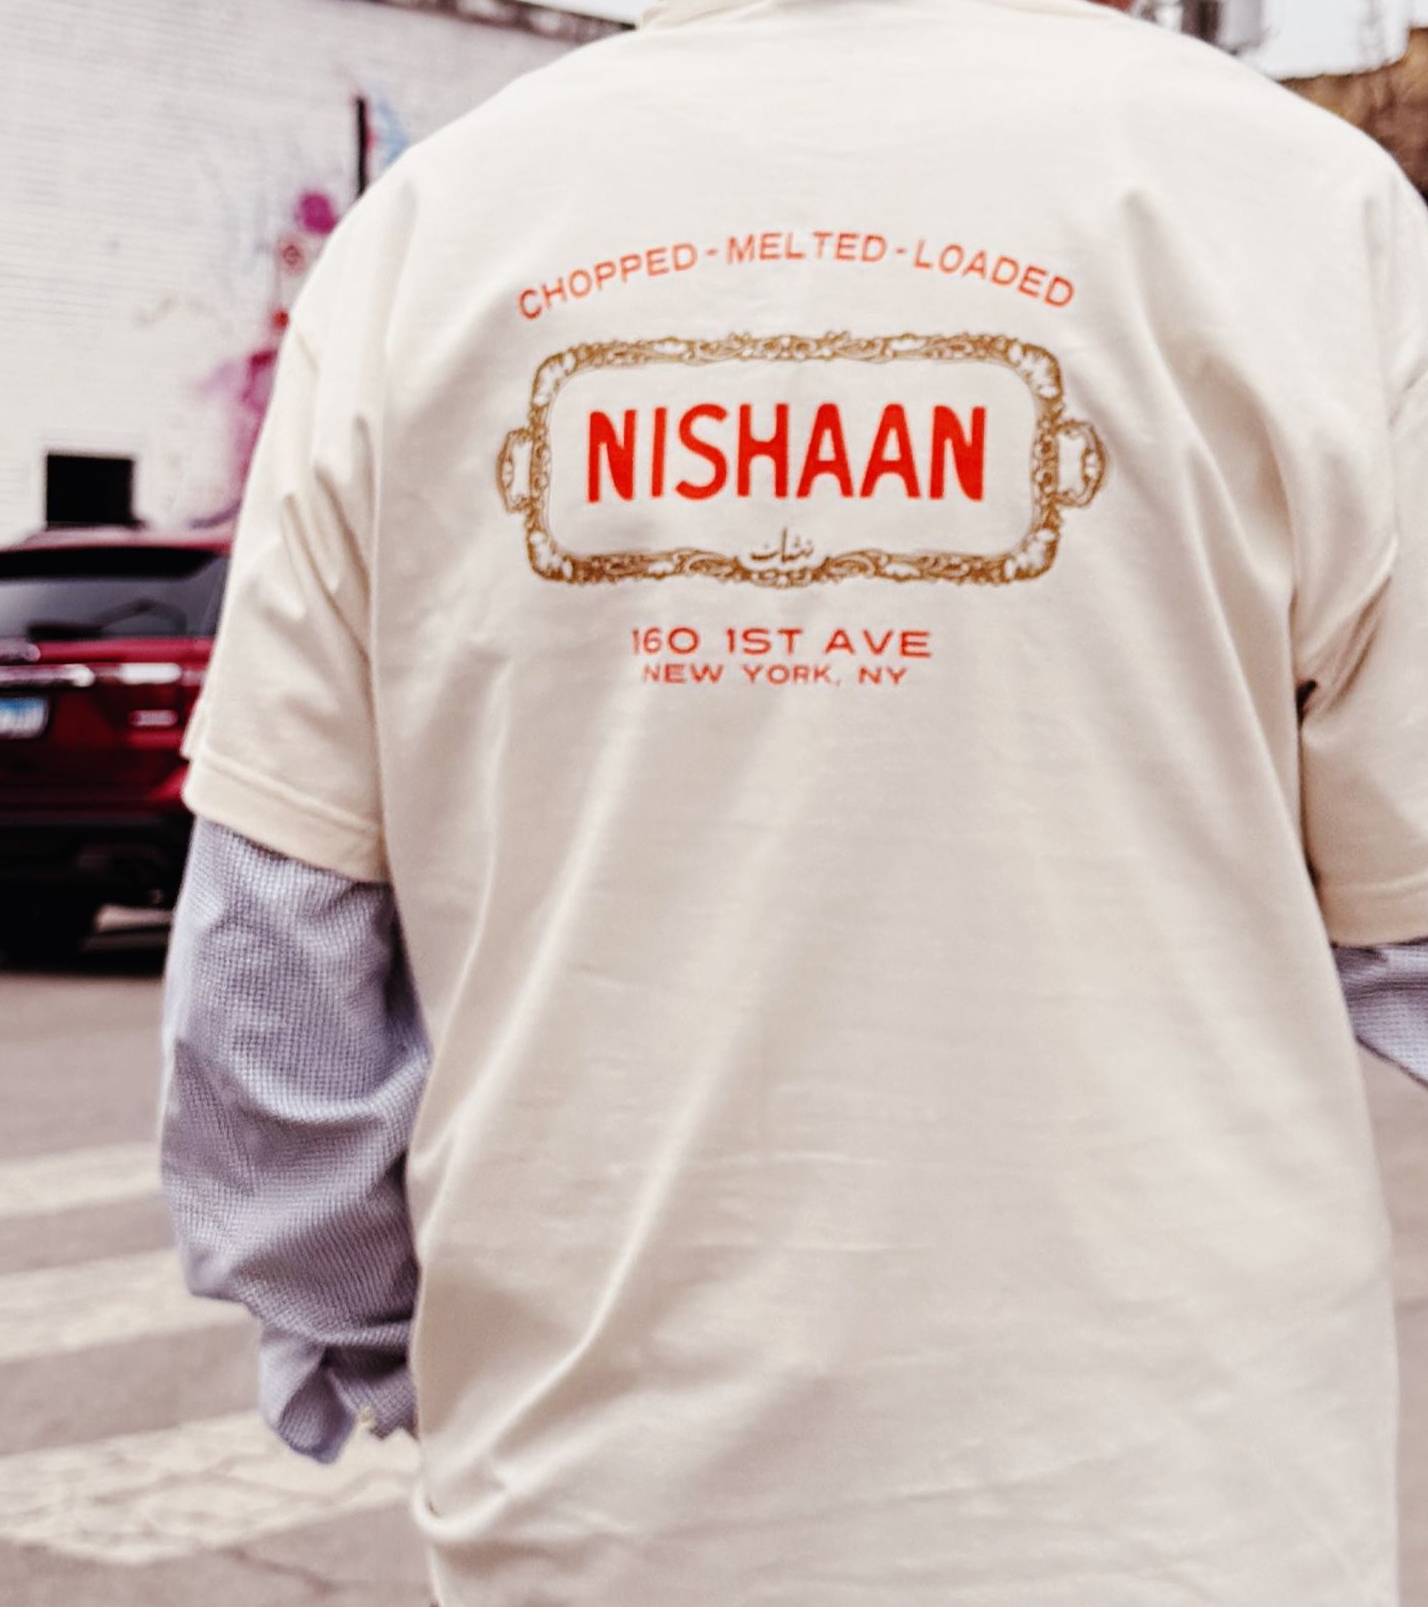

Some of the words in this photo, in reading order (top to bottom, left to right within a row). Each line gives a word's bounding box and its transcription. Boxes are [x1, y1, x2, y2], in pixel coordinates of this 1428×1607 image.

[586, 402, 987, 504] NISHAAN
[630, 625, 701, 656] 160
[724, 626, 804, 656] 1ST
[823, 628, 933, 658] AVE
[642, 663, 724, 684] NEW
[741, 663, 841, 688] YORK,
[856, 665, 908, 685] NY
